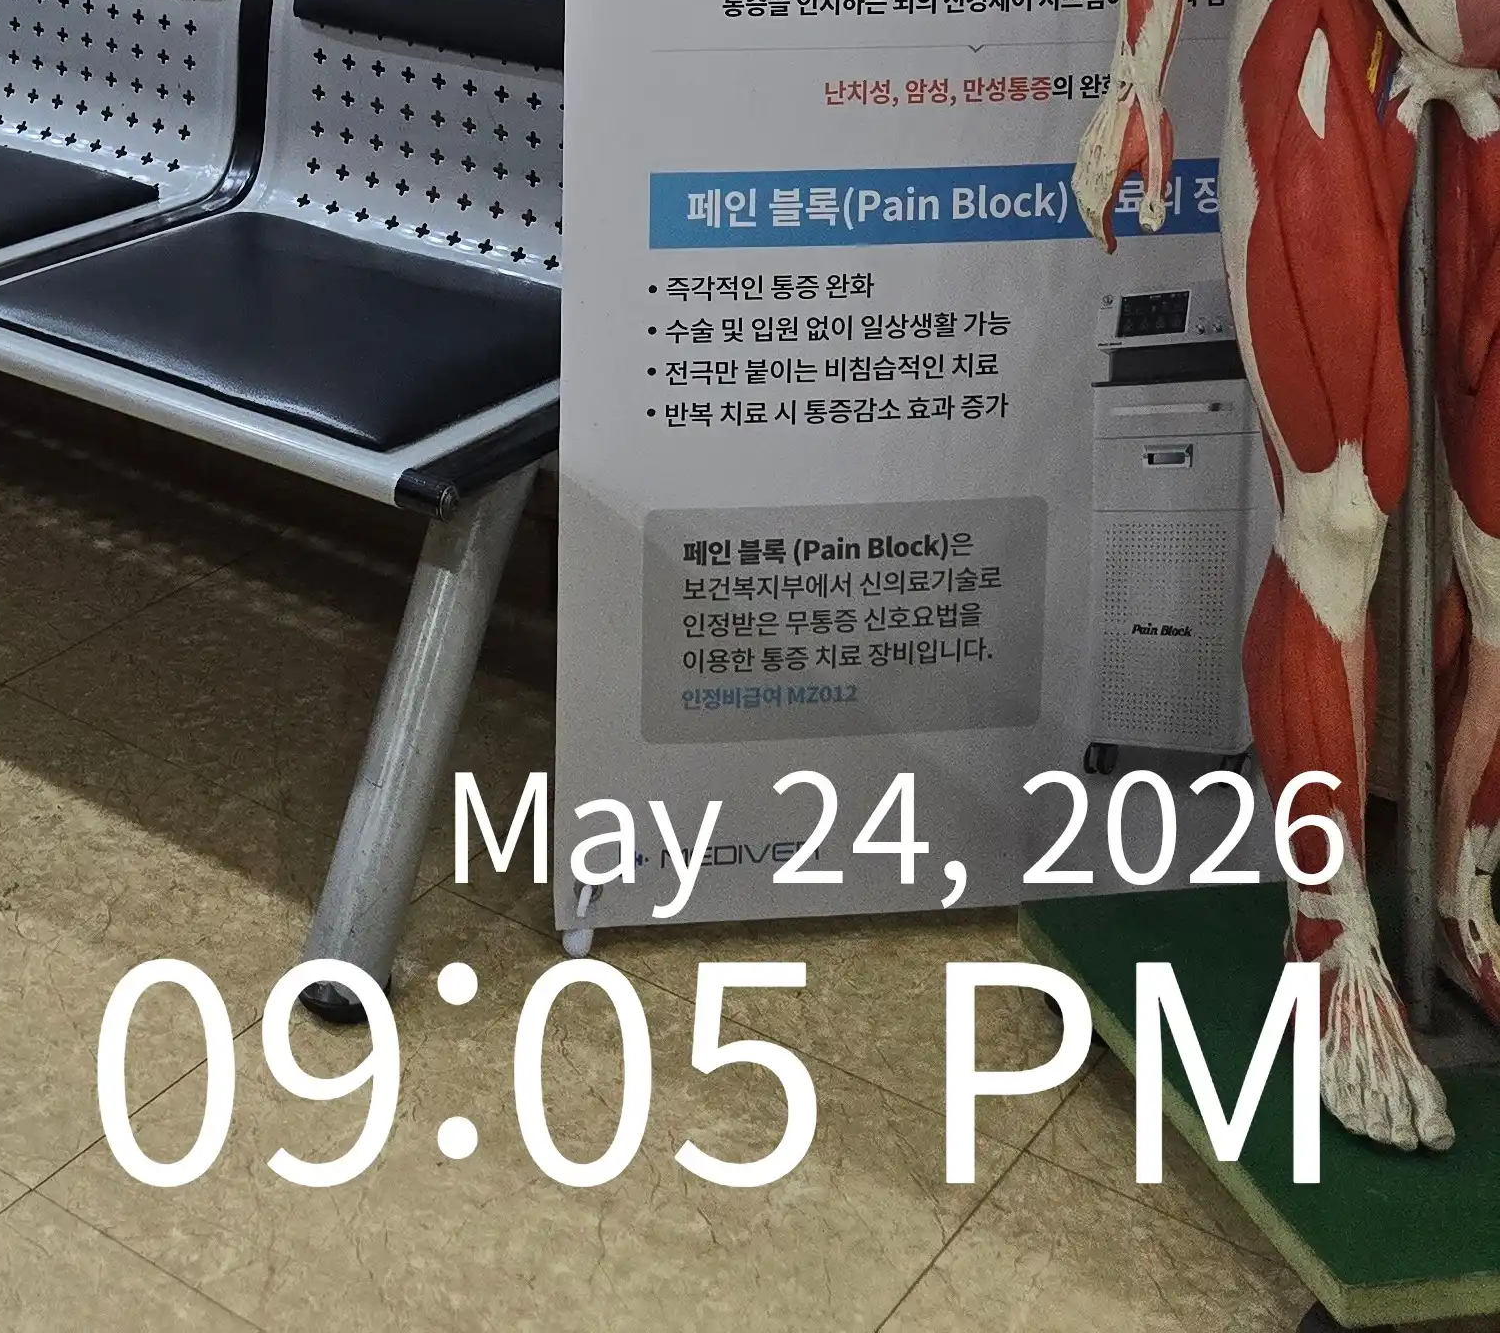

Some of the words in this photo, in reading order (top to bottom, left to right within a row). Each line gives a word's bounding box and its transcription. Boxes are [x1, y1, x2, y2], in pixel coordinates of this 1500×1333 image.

[826, 80, 898, 107] 난치성,
[906, 79, 956, 106] 암성,
[964, 75, 1072, 102] 만성통증의
[687, 188, 756, 228] 페인
[769, 187, 939, 230] 블록(Pain
[953, 181, 1067, 223] Block)
[666, 275, 762, 301] 즉각적인
[771, 275, 819, 299] 통증
[826, 273, 874, 298] 완화
[666, 318, 714, 343] 수술
[722, 318, 743, 342] 및
[752, 317, 797, 342] 입원
[807, 315, 852, 341] 없이
[862, 312, 957, 339] 일상생활
[964, 311, 1011, 336] 가능
[666, 360, 738, 385] 전극만
[745, 359, 817, 384] 붙이는
[826, 354, 943, 382] 비침습적인
[952, 353, 998, 378] 치료
[666, 403, 713, 427] 반복
[721, 401, 767, 426] 치료
[775, 400, 796, 425] 시
[804, 398, 901, 424] 통증감소
[907, 395, 955, 420] 효과
[961, 393, 1008, 419] 증가
[684, 540, 730, 566] 페인
[738, 539, 786, 565] 블록
[794, 537, 860, 566] (Pain
[868, 533, 973, 561] Block)은
[683, 573, 851, 601] 보건복지부에서
[860, 567, 1002, 596] 신의료기술로
[684, 612, 779, 637] 인정받은
[786, 609, 857, 635] 무통증
[864, 603, 982, 631] 신호요법을
[1131, 623, 1160, 637] Pain
[1162, 624, 1192, 638] Block
[683, 648, 755, 673] 이용한
[761, 647, 808, 672] 통증
[816, 645, 861, 669] 치료
[869, 637, 992, 666] 장비입니다.
[788, 683, 858, 705] MZ012
